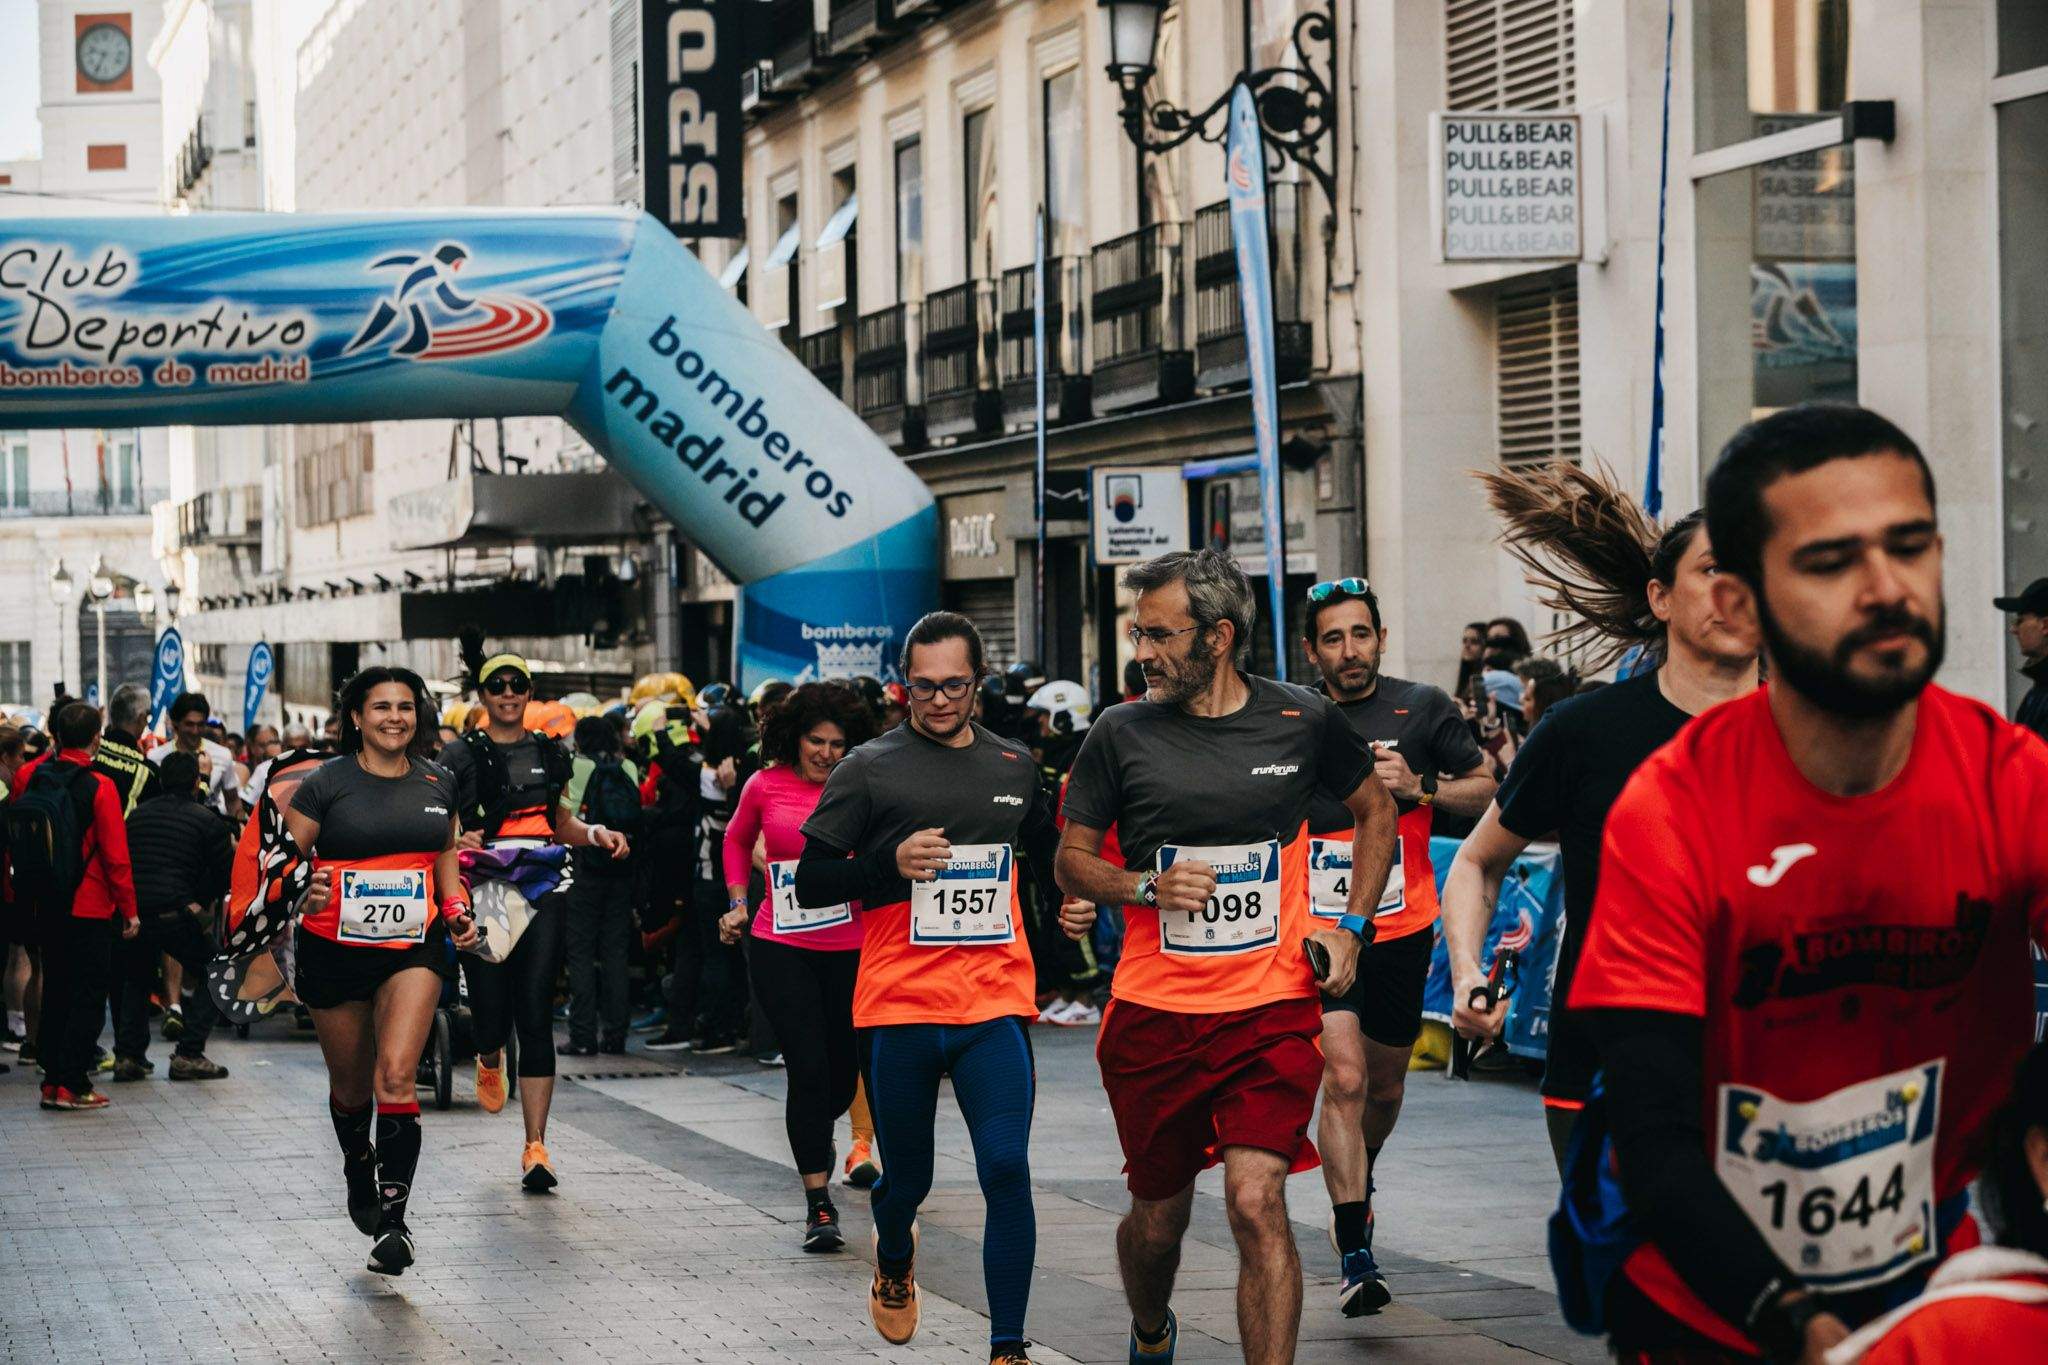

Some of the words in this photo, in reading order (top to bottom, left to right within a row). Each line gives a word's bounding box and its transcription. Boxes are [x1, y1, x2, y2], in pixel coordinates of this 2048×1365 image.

[1446, 123, 1573, 144] PULL&BEAR
[1446, 150, 1574, 171] PULL&BEAR
[1447, 177, 1574, 198] PULL&BEAR
[1447, 204, 1575, 225] PULL&BEAR
[1448, 231, 1575, 252] PULL&BEAR
[0, 248, 128, 292] Club
[26, 290, 305, 363] Deportivo
[0, 360, 140, 386] bomberos
[156, 357, 193, 385] de
[209, 356, 307, 383] madrid
[648, 314, 853, 518] bomberos
[604, 367, 786, 529] madrid
[801, 622, 894, 640] bomberos
[947, 860, 996, 871] BOMBEROS
[1209, 861, 1260, 874] MBEROS
[933, 887, 998, 915] 1557
[363, 903, 406, 924] 270
[1760, 1161, 1906, 1237] 1644
